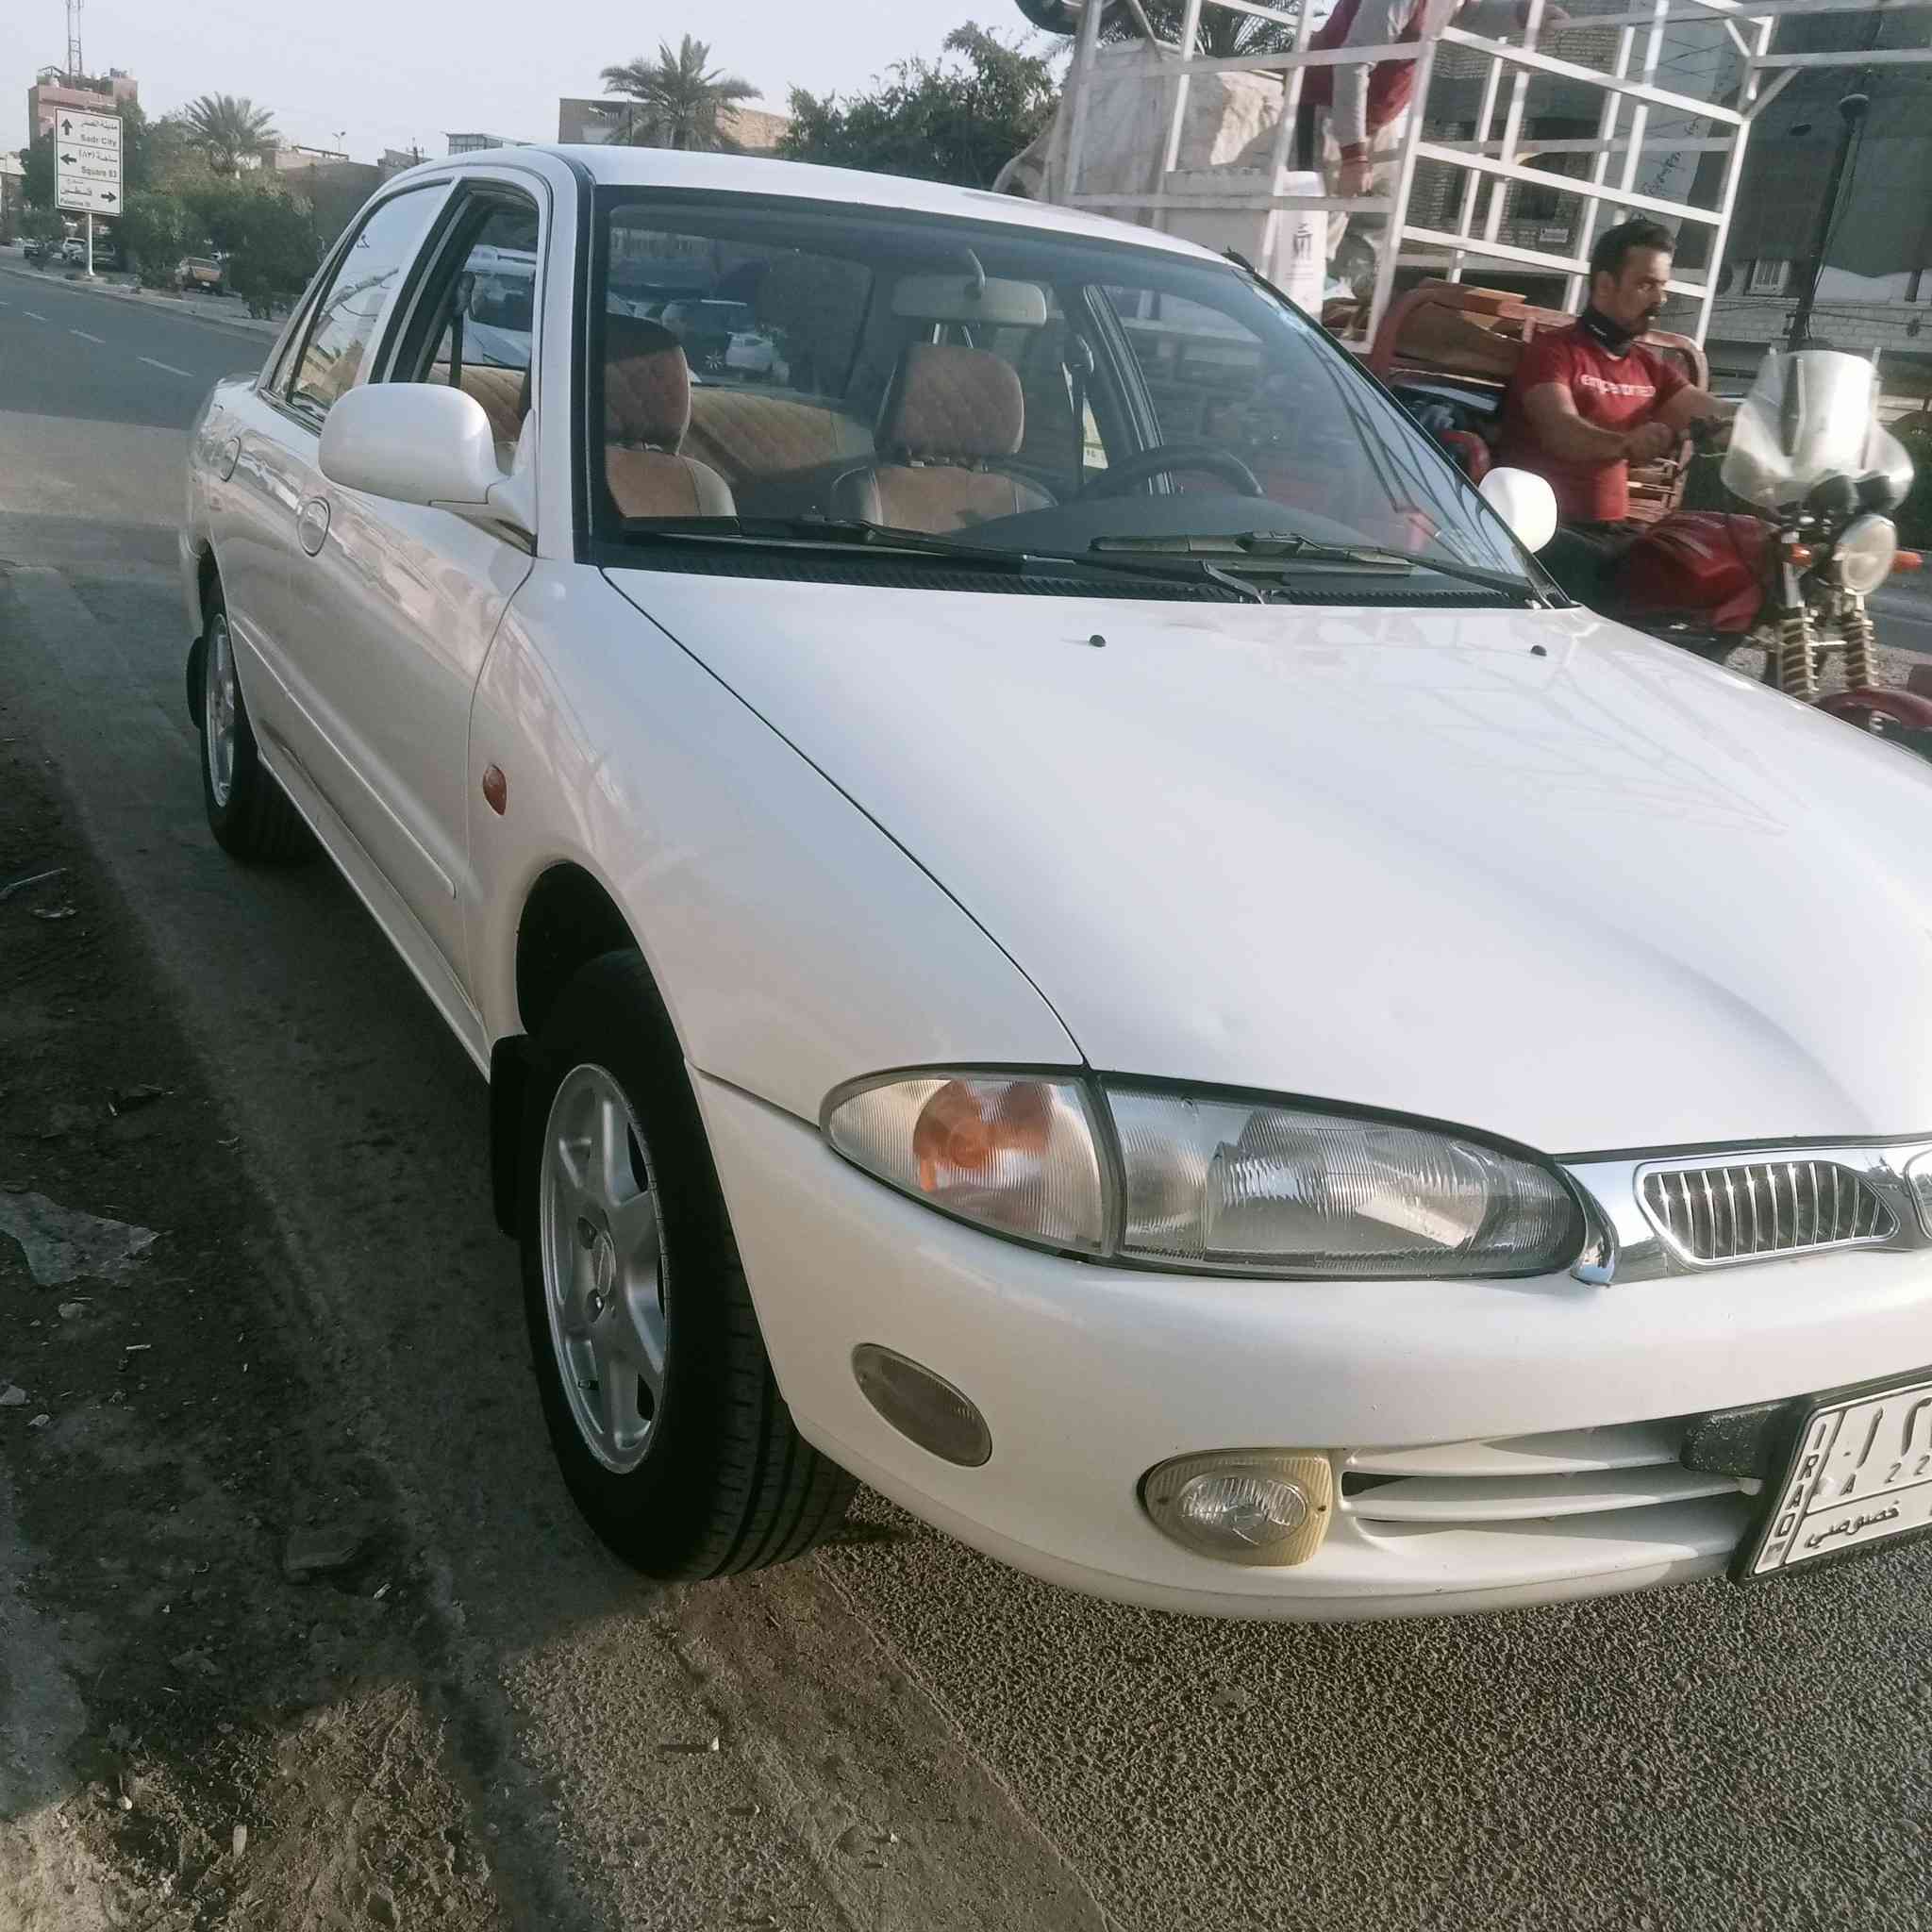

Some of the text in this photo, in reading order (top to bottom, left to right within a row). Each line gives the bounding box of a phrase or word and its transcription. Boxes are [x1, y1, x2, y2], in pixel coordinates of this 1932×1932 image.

[81, 134, 117, 147] Sadr City
[81, 166, 107, 176] Square
[1804, 1500, 1900, 1549] خصوصي
